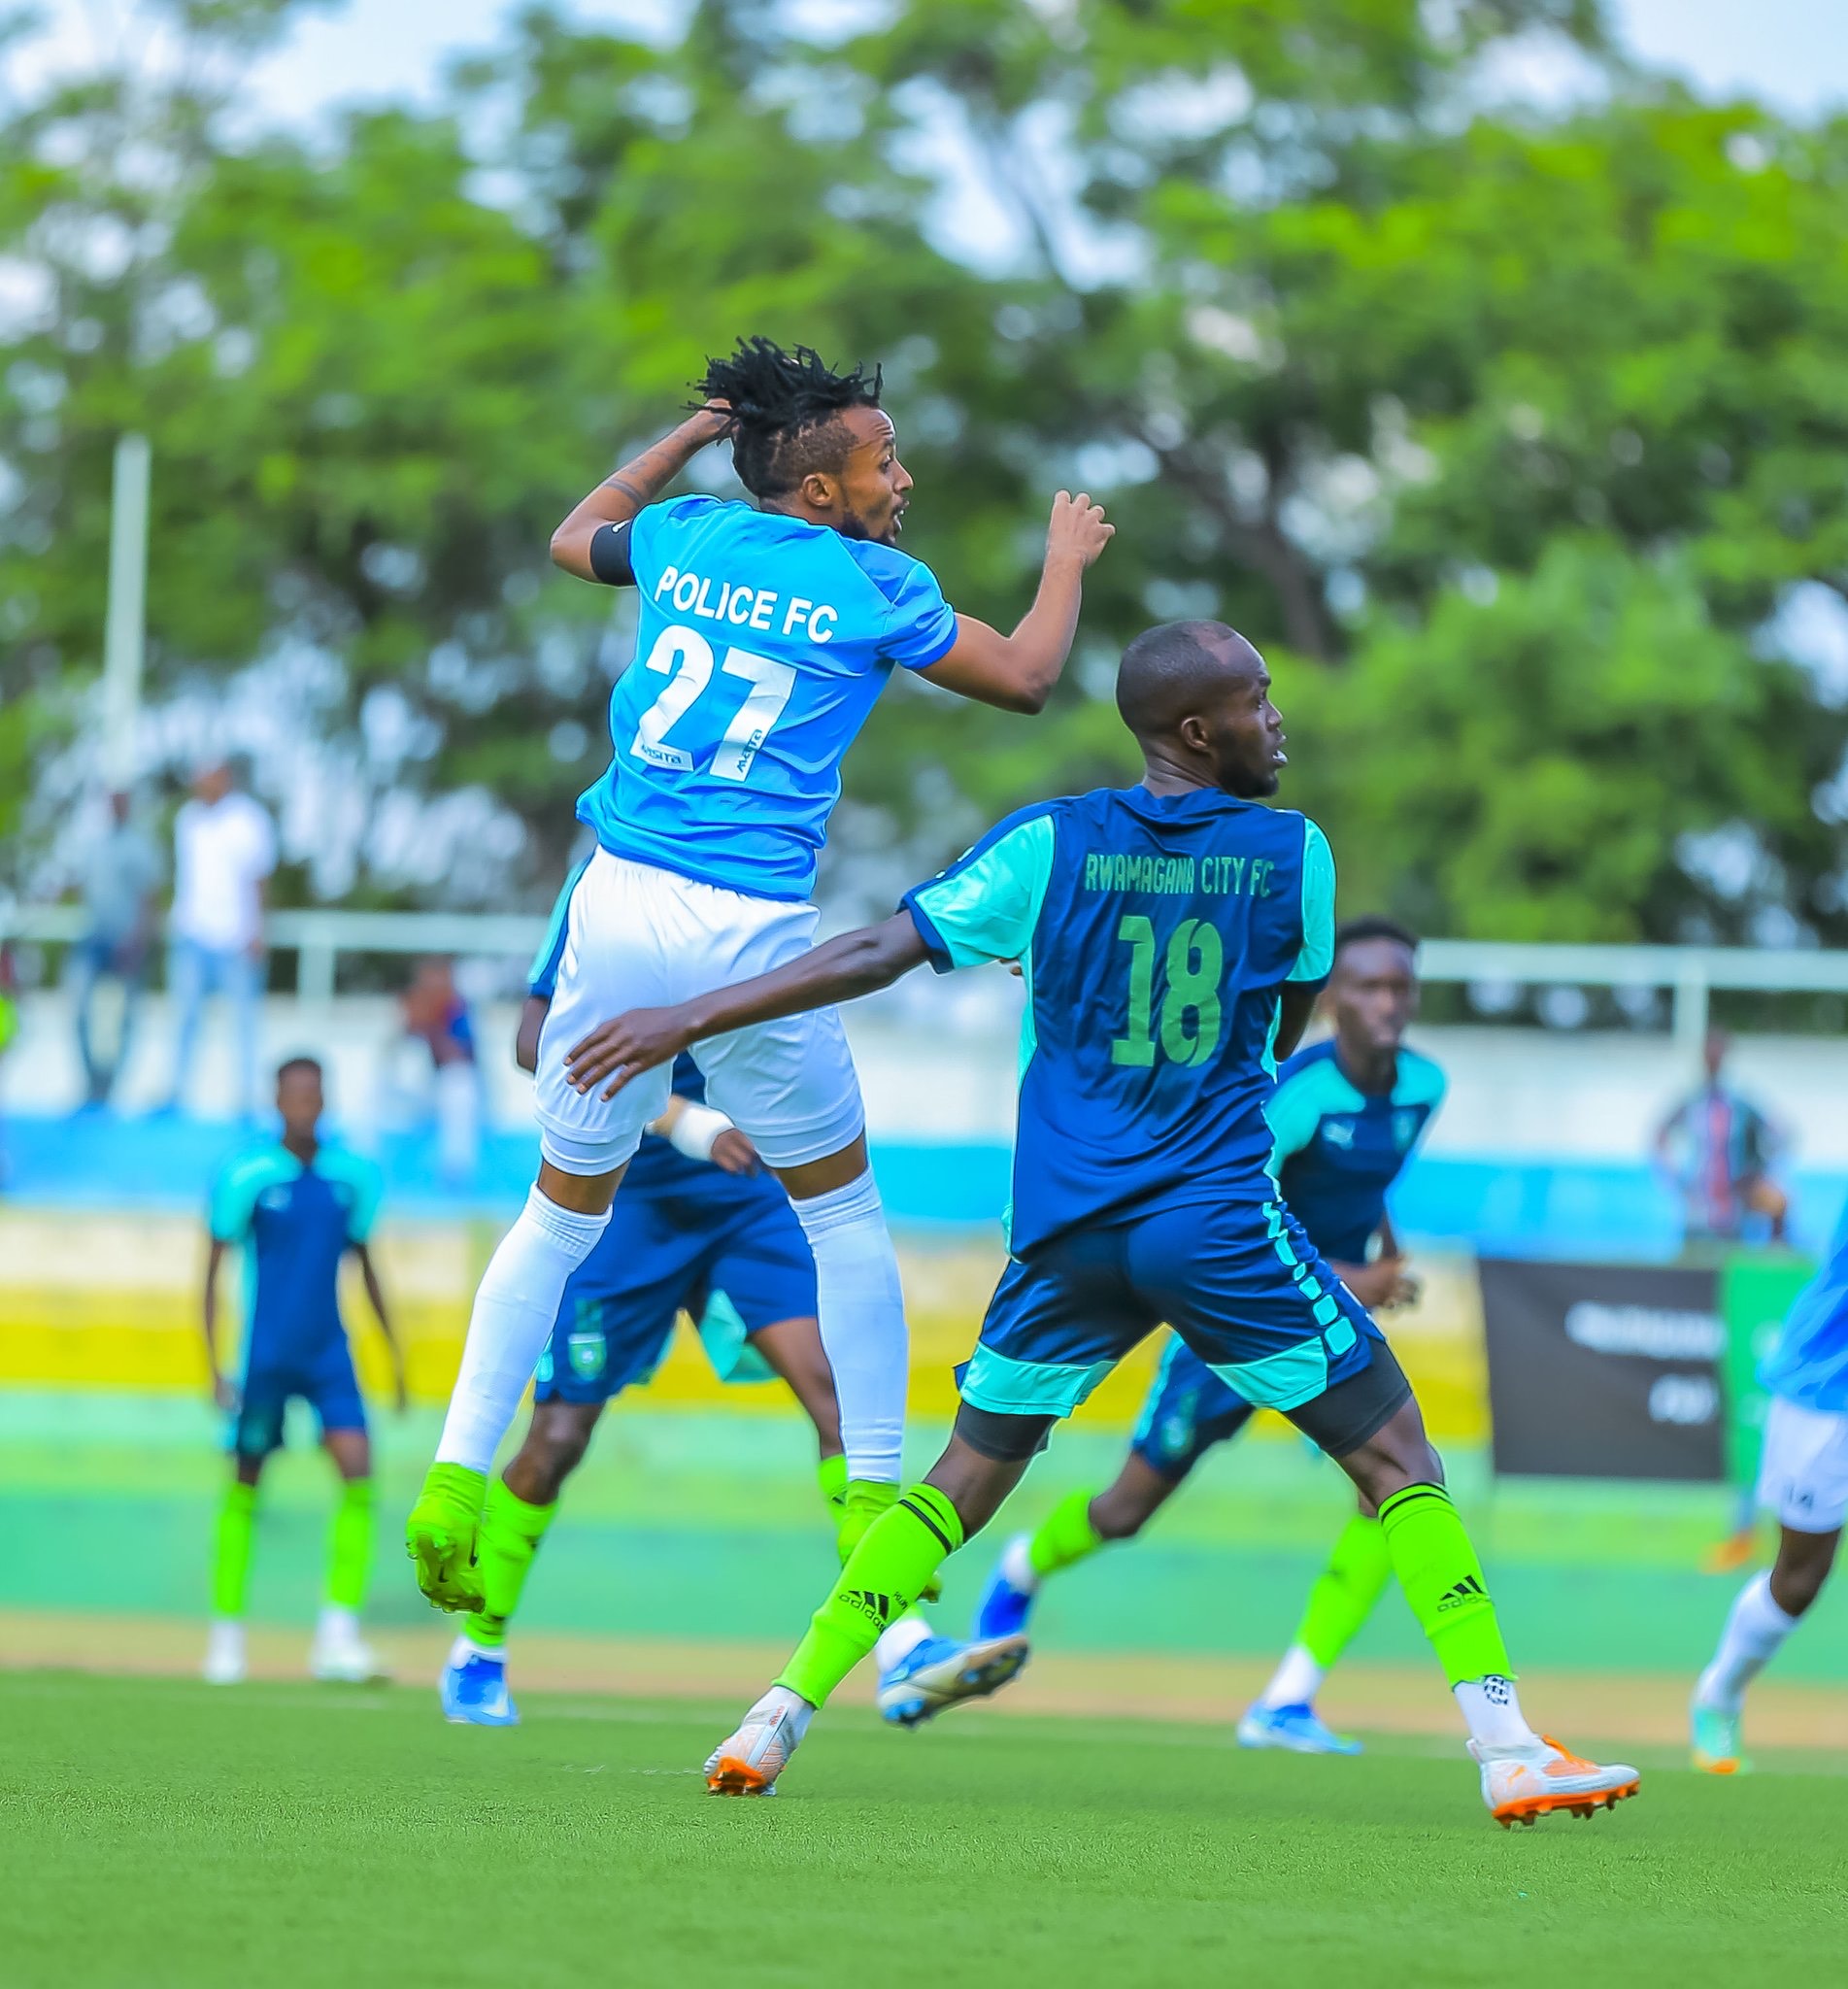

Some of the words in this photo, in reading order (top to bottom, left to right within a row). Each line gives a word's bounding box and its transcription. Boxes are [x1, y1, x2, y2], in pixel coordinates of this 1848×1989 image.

[655, 565, 778, 630] POLICE
[782, 596, 838, 644] FC
[629, 624, 797, 782] 27
[1085, 853, 1195, 894] RWAMAGANA
[1201, 857, 1247, 894] CITY
[1250, 859, 1274, 898] FC
[1112, 915, 1224, 1068] 18
